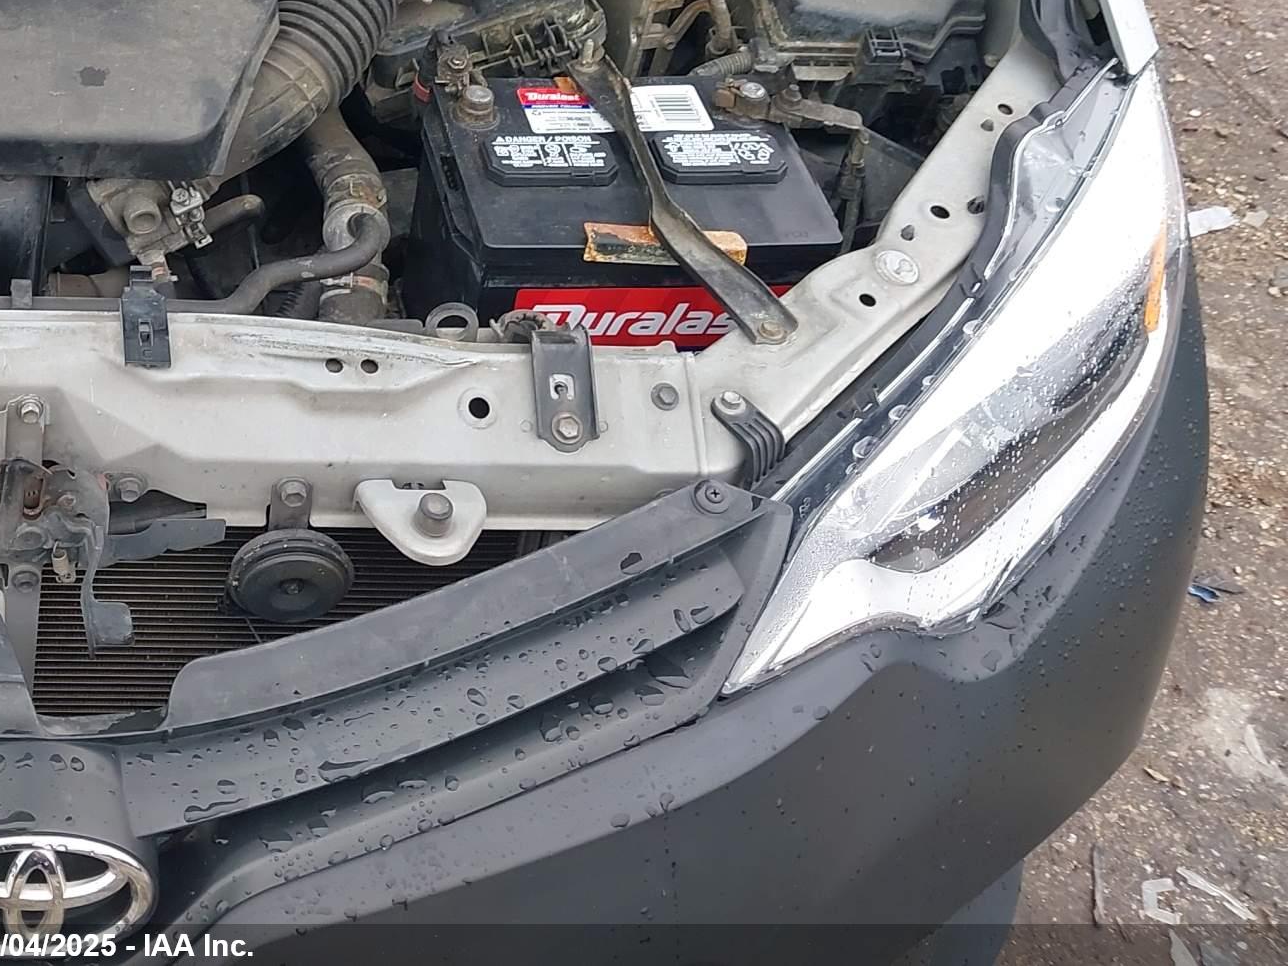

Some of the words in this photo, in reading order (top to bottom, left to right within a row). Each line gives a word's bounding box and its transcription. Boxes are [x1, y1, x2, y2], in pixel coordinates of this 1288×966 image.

[524, 92, 580, 101] Duralast
[504, 135, 546, 143] DANGER
[555, 135, 592, 143] POISON
[533, 302, 736, 336] Duralas
